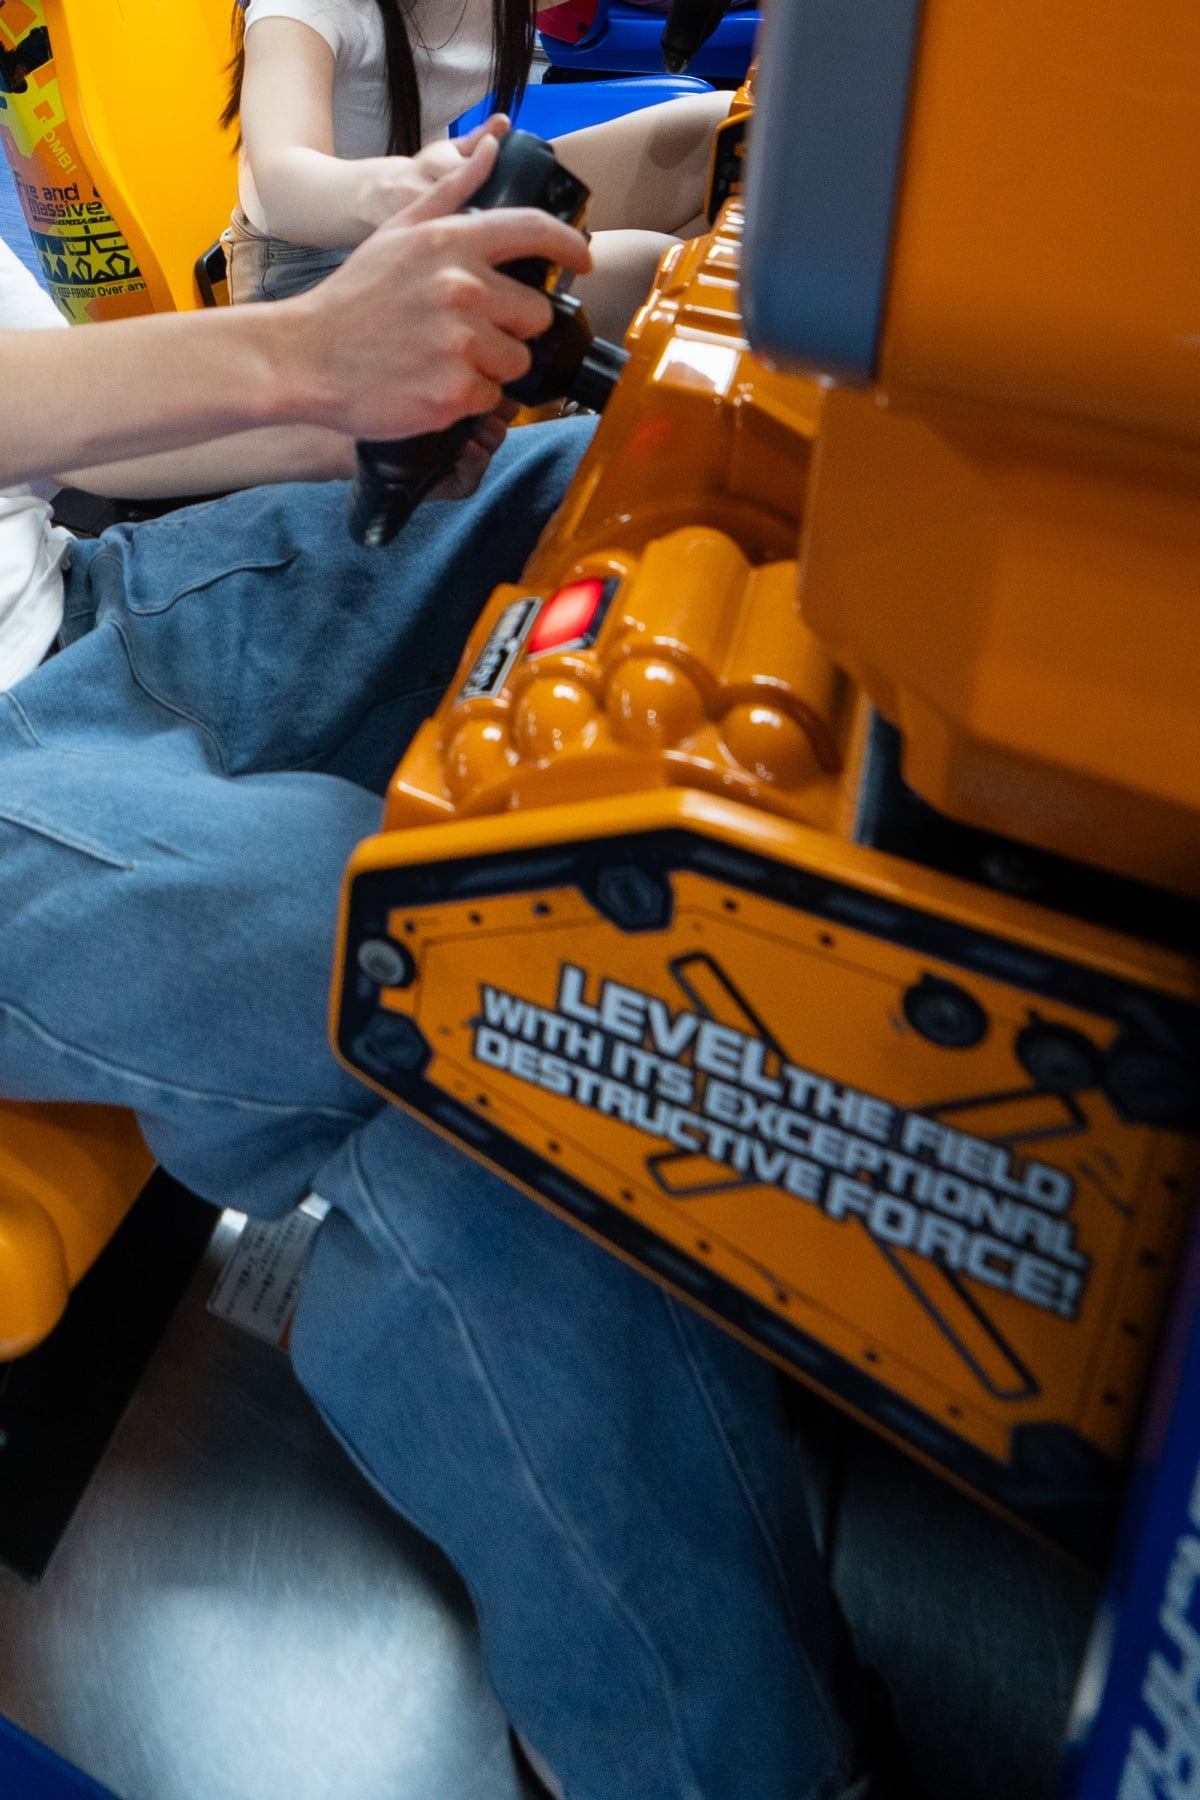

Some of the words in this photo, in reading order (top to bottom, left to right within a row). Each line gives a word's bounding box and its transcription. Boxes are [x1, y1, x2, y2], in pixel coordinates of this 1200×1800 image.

[29, 200, 105, 219] Massive
[42, 182, 79, 201] and
[98, 286, 124, 298] Over
[484, 986, 602, 1068] WITH
[611, 1041, 695, 1104] ITS
[704, 1077, 1089, 1270] EXCEPTIONAL
[561, 965, 783, 1098] LEVEL
[782, 1063, 896, 1143] THE
[903, 1113, 1073, 1213] FIELD
[475, 1024, 825, 1201] DESTRUCTIVE
[825, 1173, 1082, 1318] FORCE!
